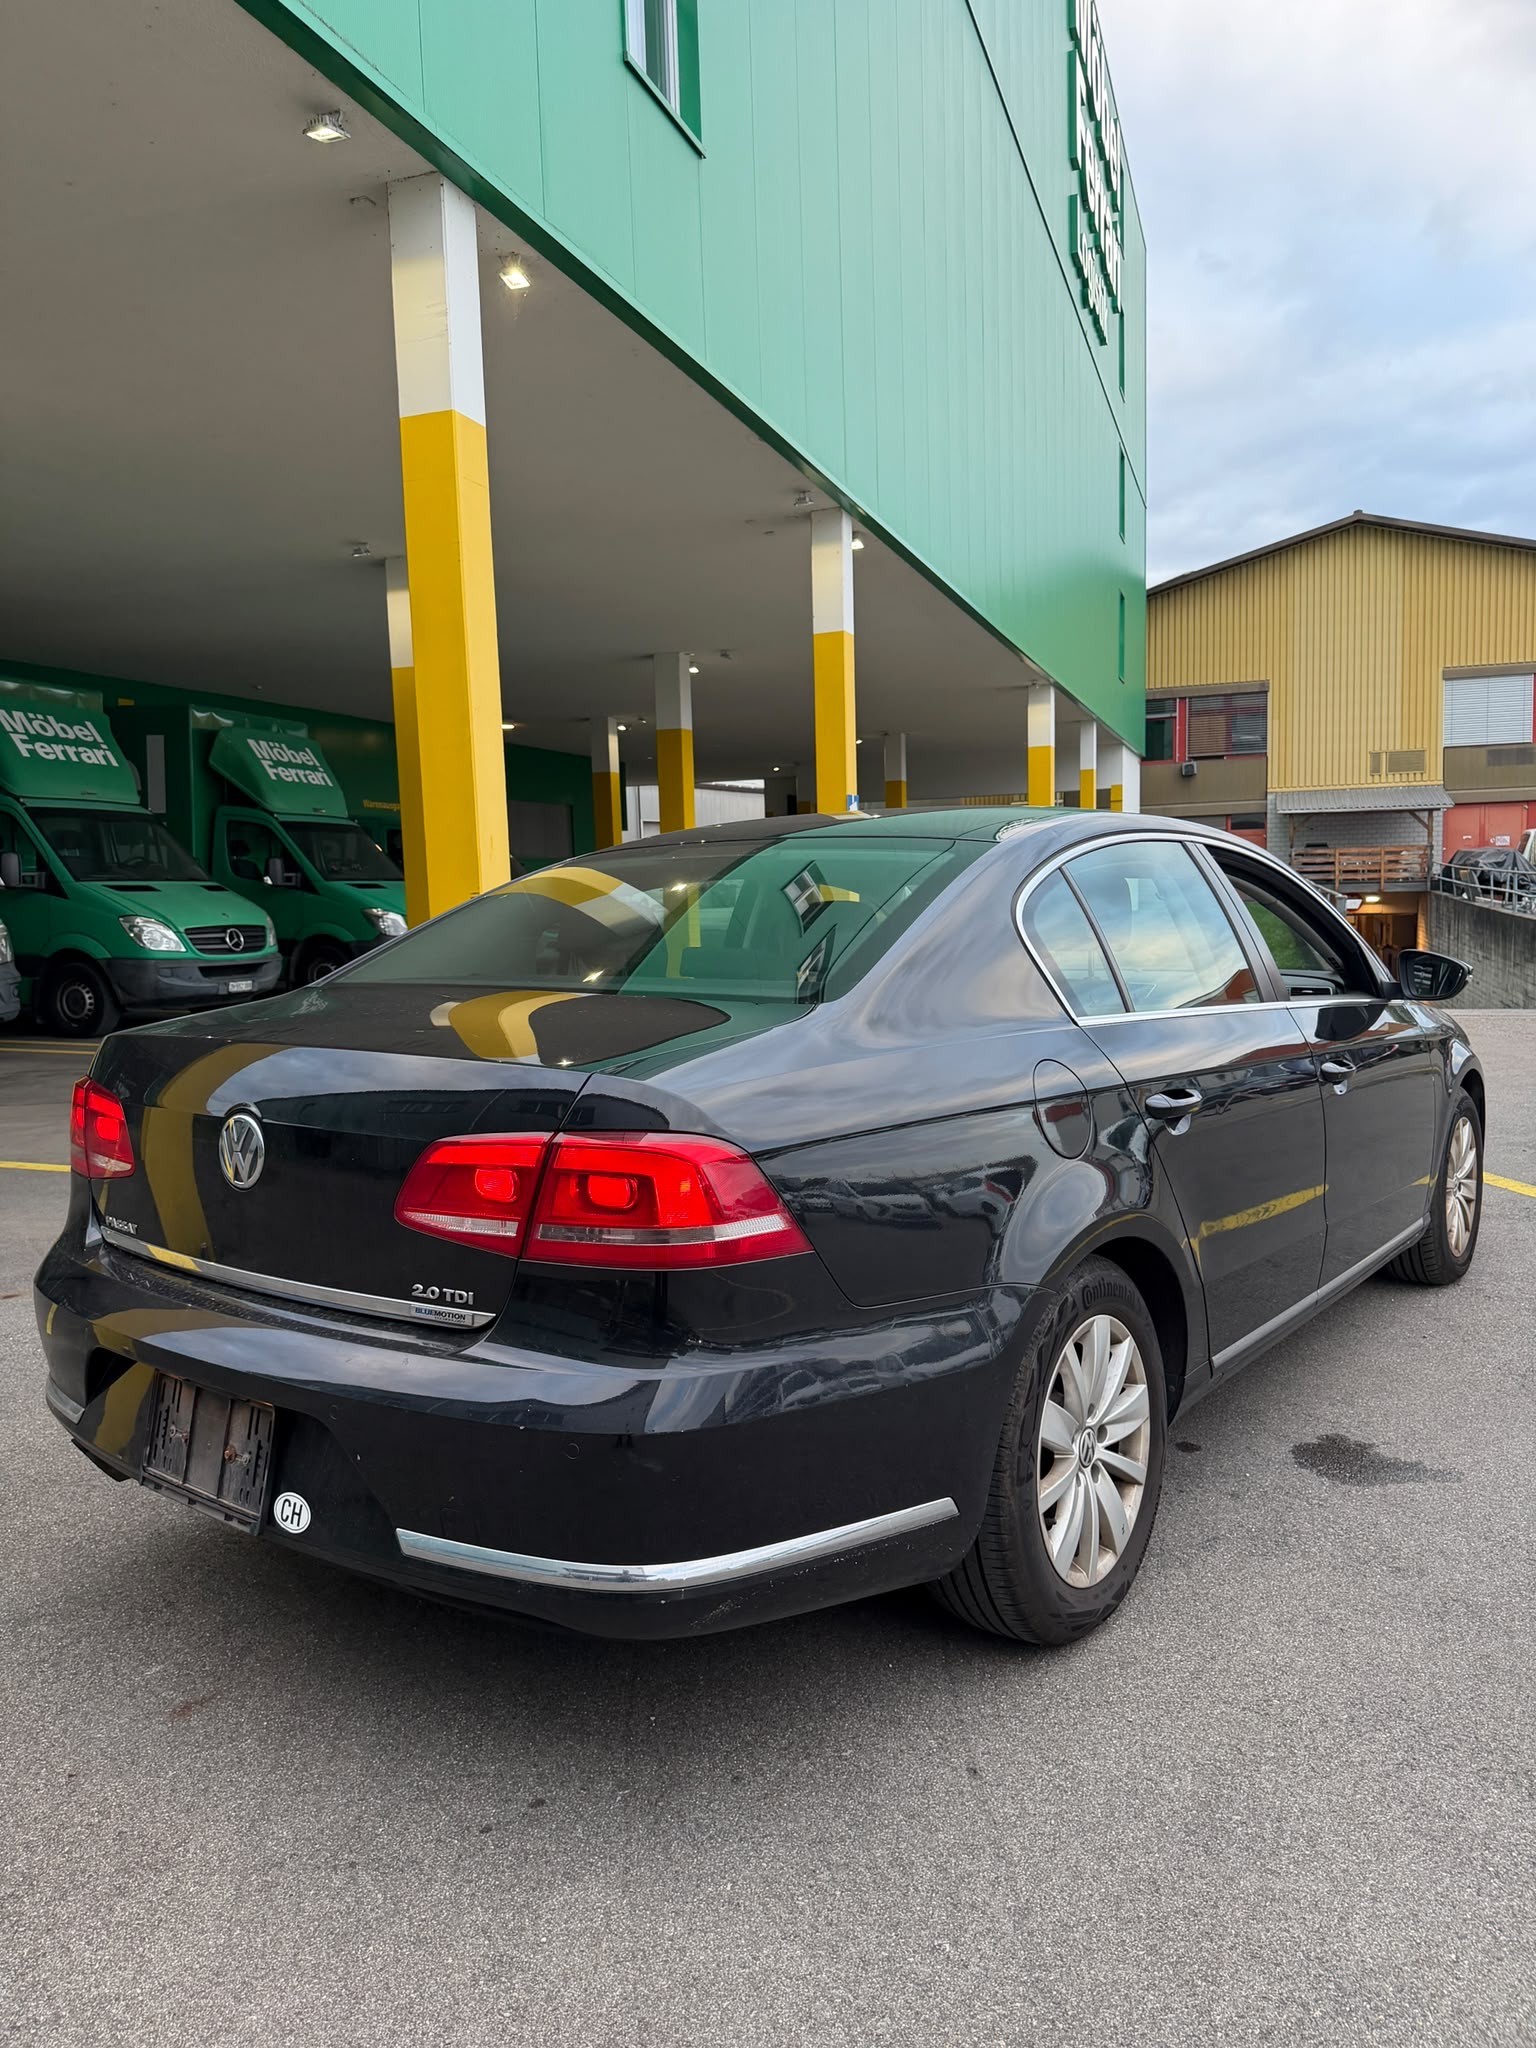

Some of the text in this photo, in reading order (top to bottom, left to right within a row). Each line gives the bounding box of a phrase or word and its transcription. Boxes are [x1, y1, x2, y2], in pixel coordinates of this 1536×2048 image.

[1074, 48, 1121, 313] Ferrari
[0, 708, 104, 743] Möbel
[9, 732, 119, 767] Ferrari
[247, 738, 321, 767] Möbel
[260, 759, 334, 787] Ferrari
[411, 1283, 474, 1305] 2.0 TDI
[280, 1498, 303, 1527] CH
